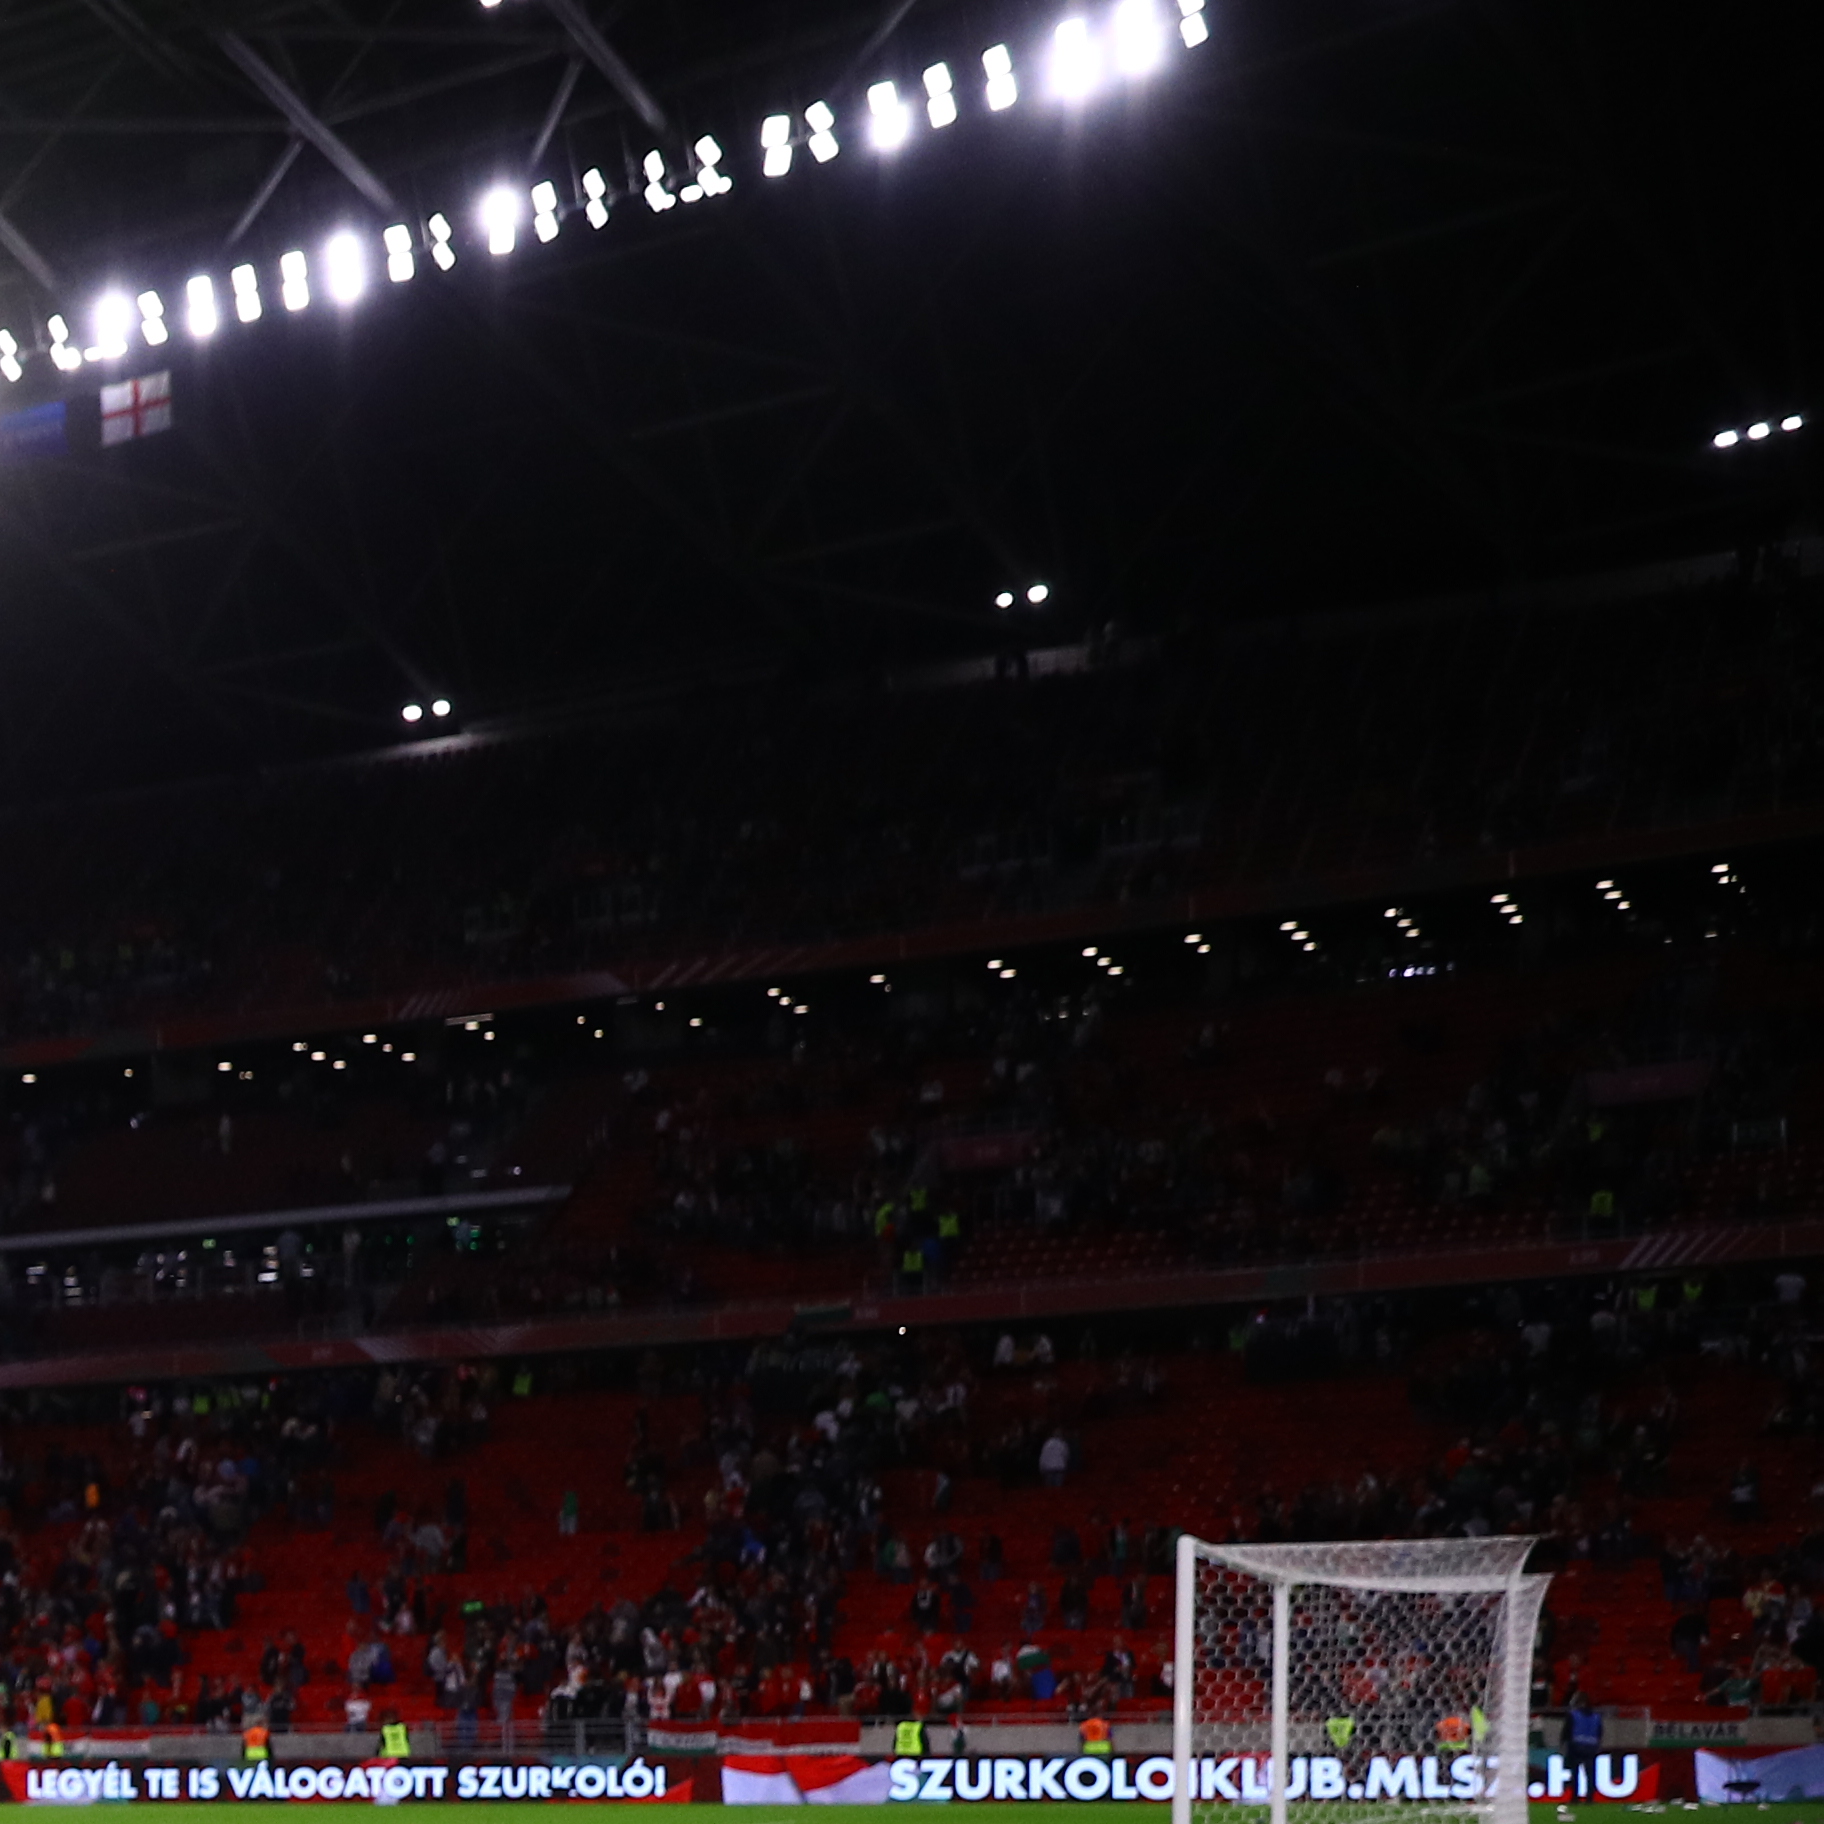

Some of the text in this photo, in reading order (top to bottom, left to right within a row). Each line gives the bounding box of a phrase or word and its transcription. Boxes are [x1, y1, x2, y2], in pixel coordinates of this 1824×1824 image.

[26, 1757, 667, 1800] LEGYÉL TE IS VÁLOGATOTT SZURKOLÓ!
